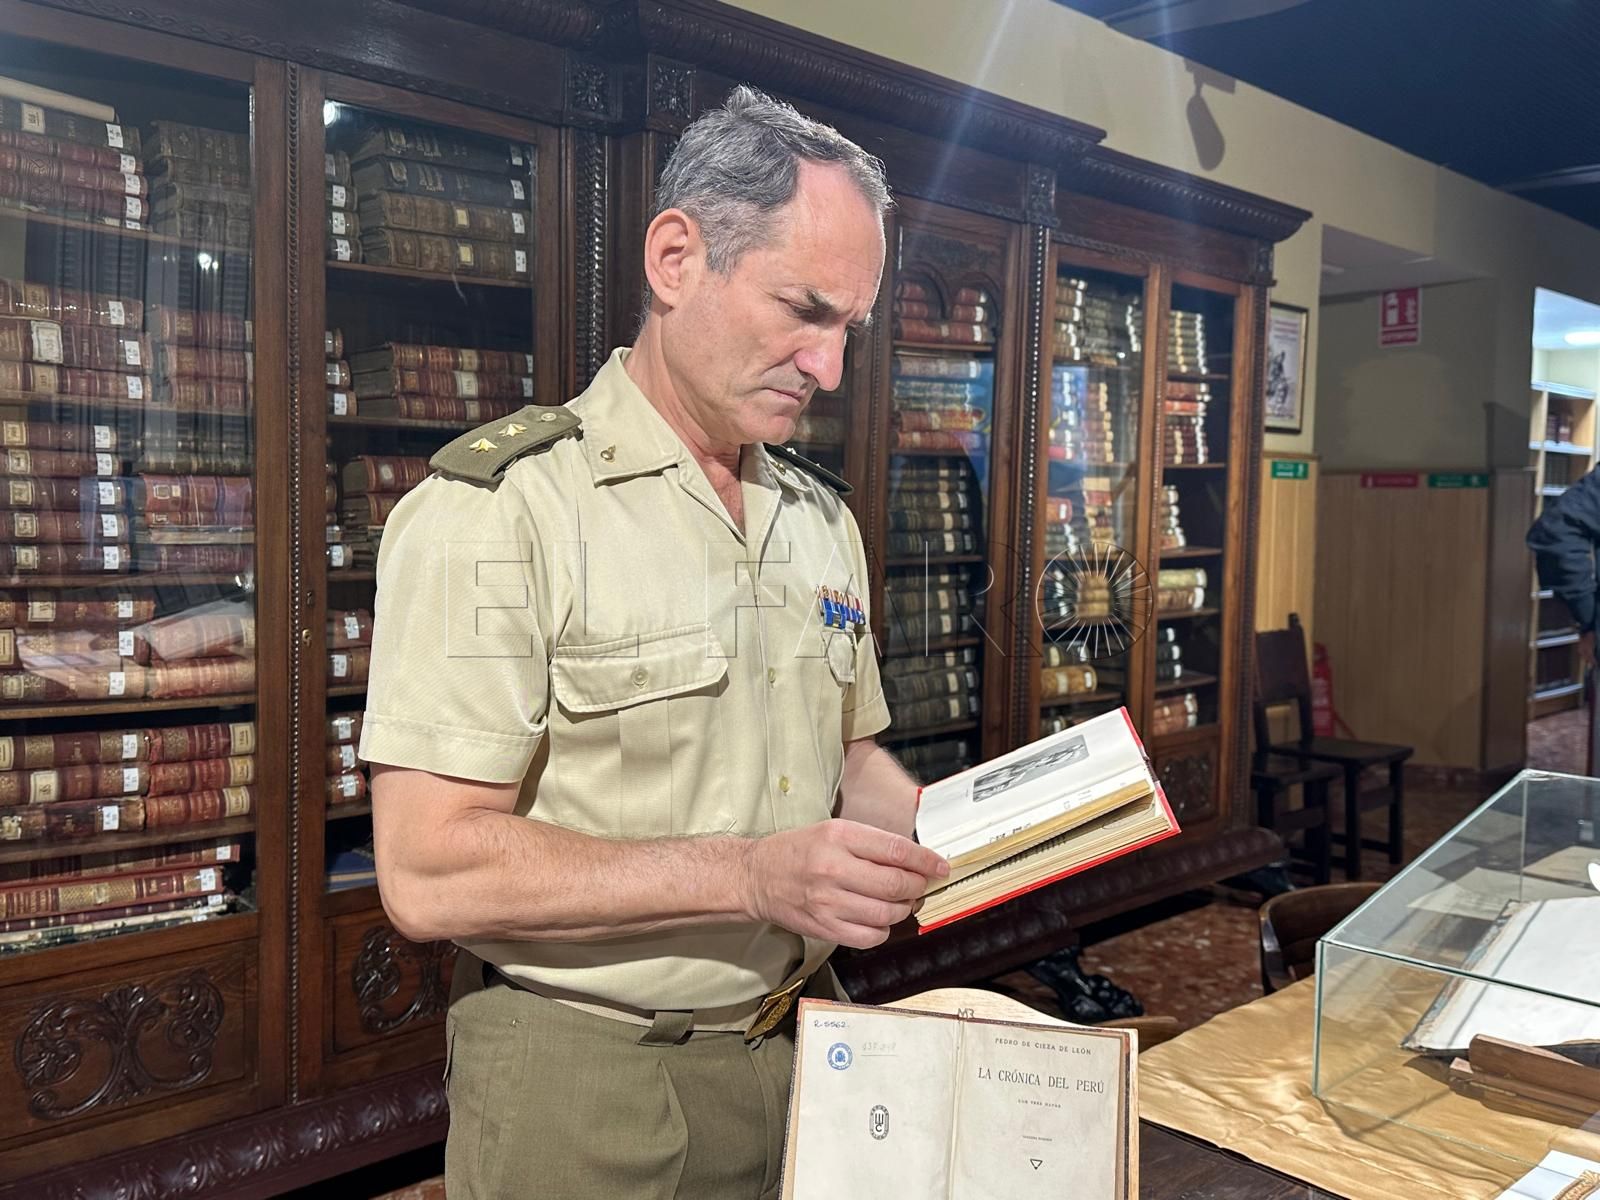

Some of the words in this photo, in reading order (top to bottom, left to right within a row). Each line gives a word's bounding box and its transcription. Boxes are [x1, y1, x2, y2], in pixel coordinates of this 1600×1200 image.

[995, 1037, 1019, 1046] PEDRO
[1022, 1039, 1031, 1047] DE
[1035, 1042, 1056, 1051] CIEZA
[1059, 1045, 1069, 1053] DE
[1072, 1046, 1092, 1055] LEÓN
[978, 1067, 992, 1080] LA
[998, 1068, 1041, 1086] CRÓNICA
[1048, 1075, 1070, 1090] DEL
[1076, 1079, 1105, 1094] PERÚ
